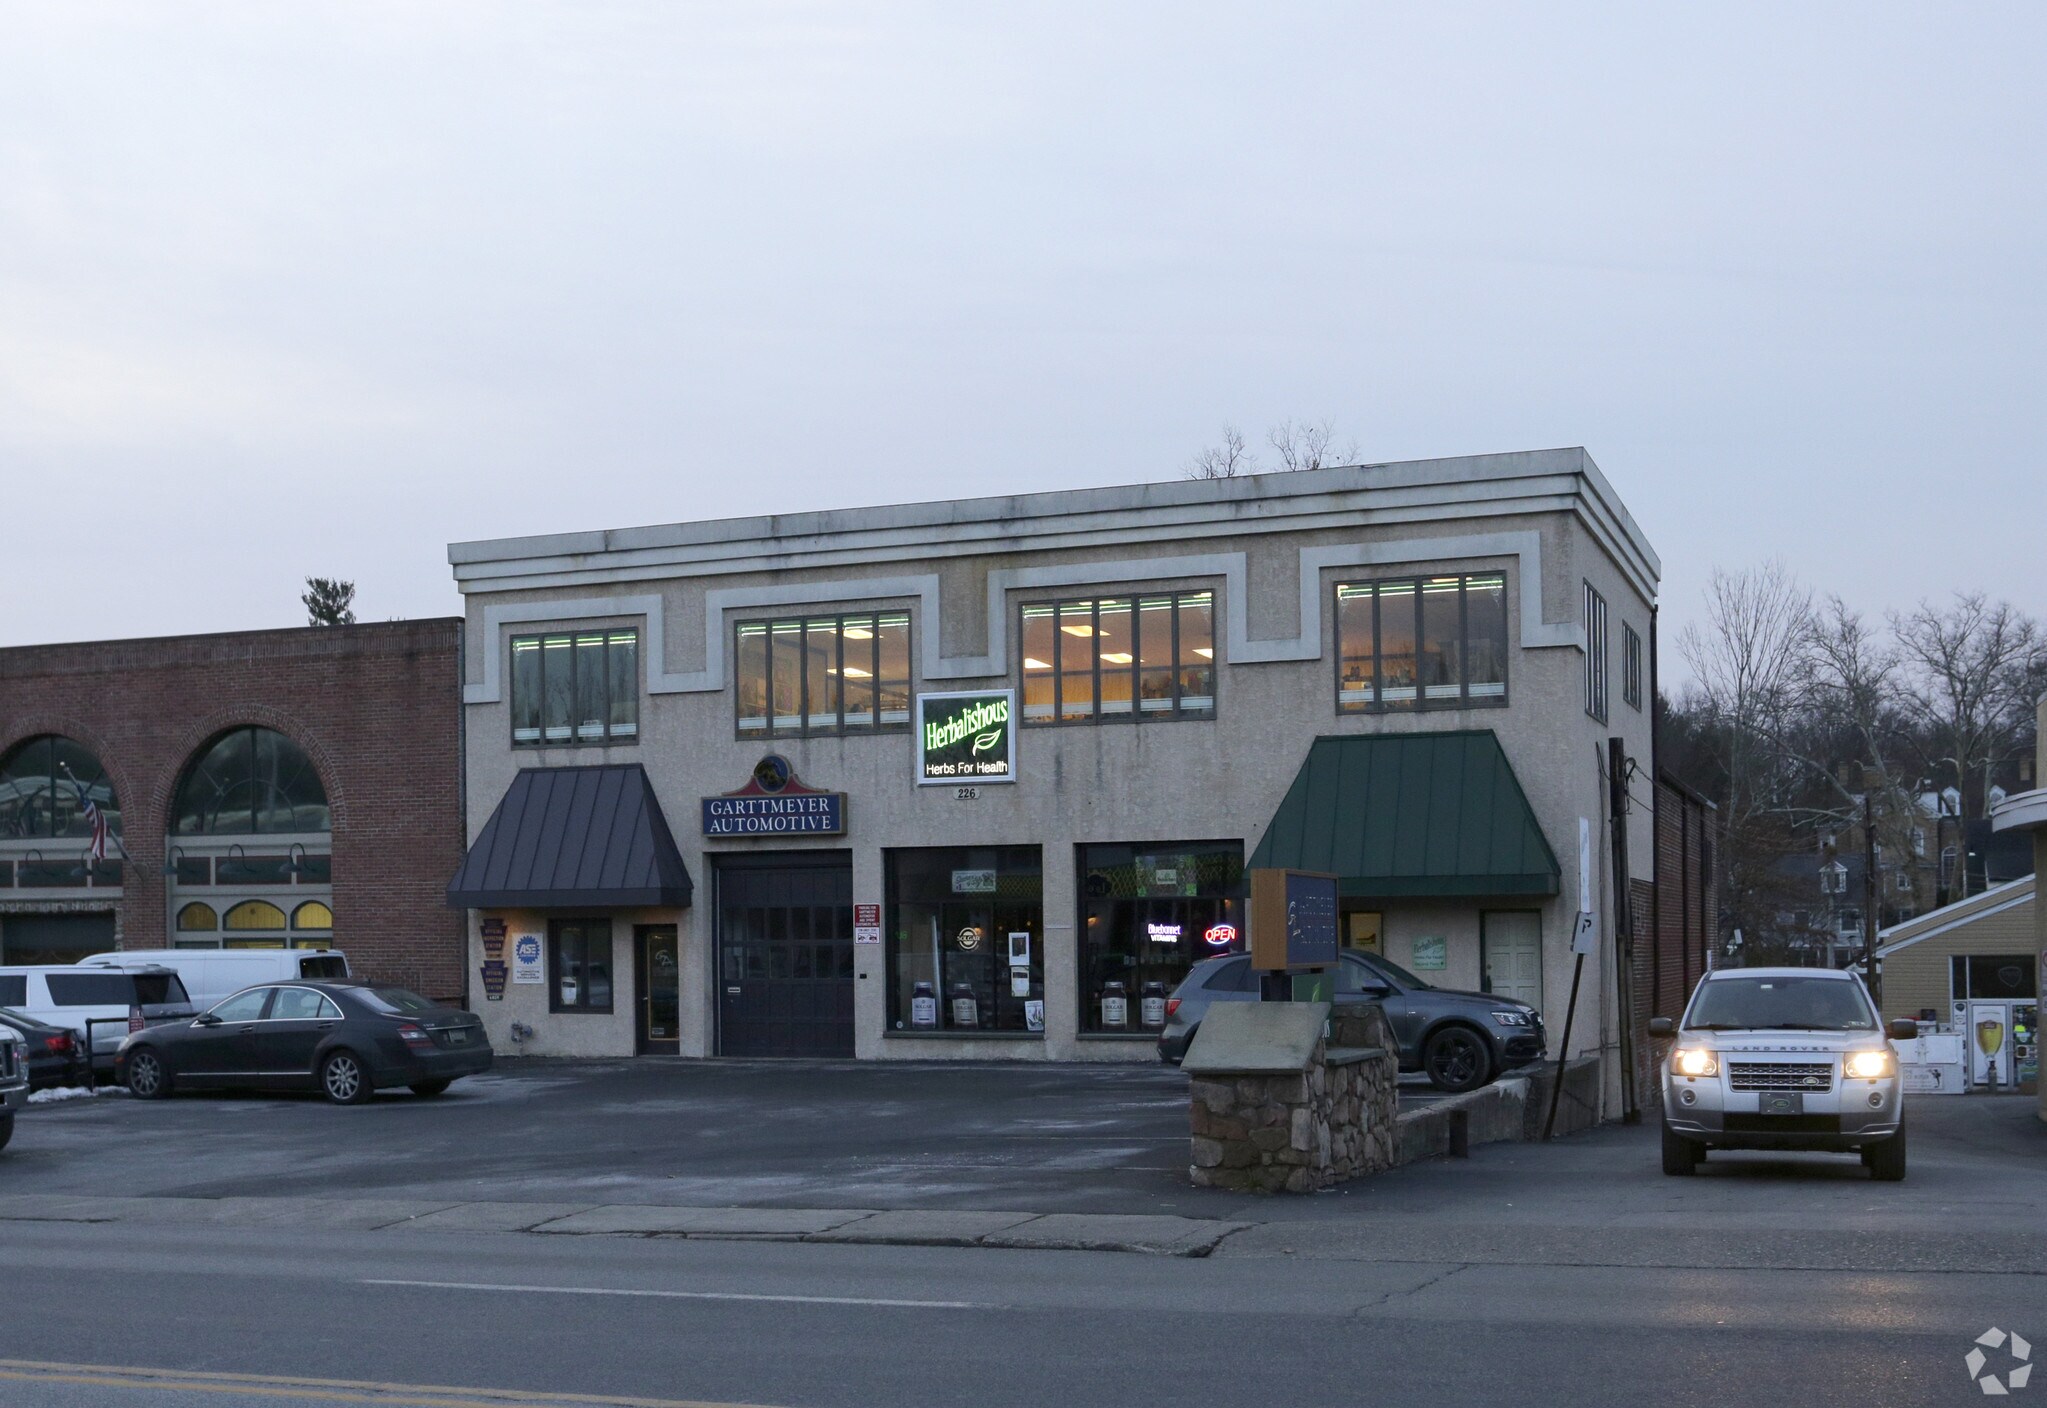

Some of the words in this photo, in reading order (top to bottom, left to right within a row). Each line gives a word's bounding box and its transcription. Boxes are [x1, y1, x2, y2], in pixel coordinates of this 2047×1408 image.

[926, 700, 1008, 750] Herbalishous
[926, 763, 956, 775] Herbs
[957, 761, 974, 773] For
[976, 760, 1008, 774] Health
[958, 788, 976, 799] 226
[710, 797, 830, 815] GARTTMEYER
[709, 815, 832, 833] AUTOMOTIVE
[1205, 928, 1236, 941] OPEN
[519, 944, 537, 954] ASE
